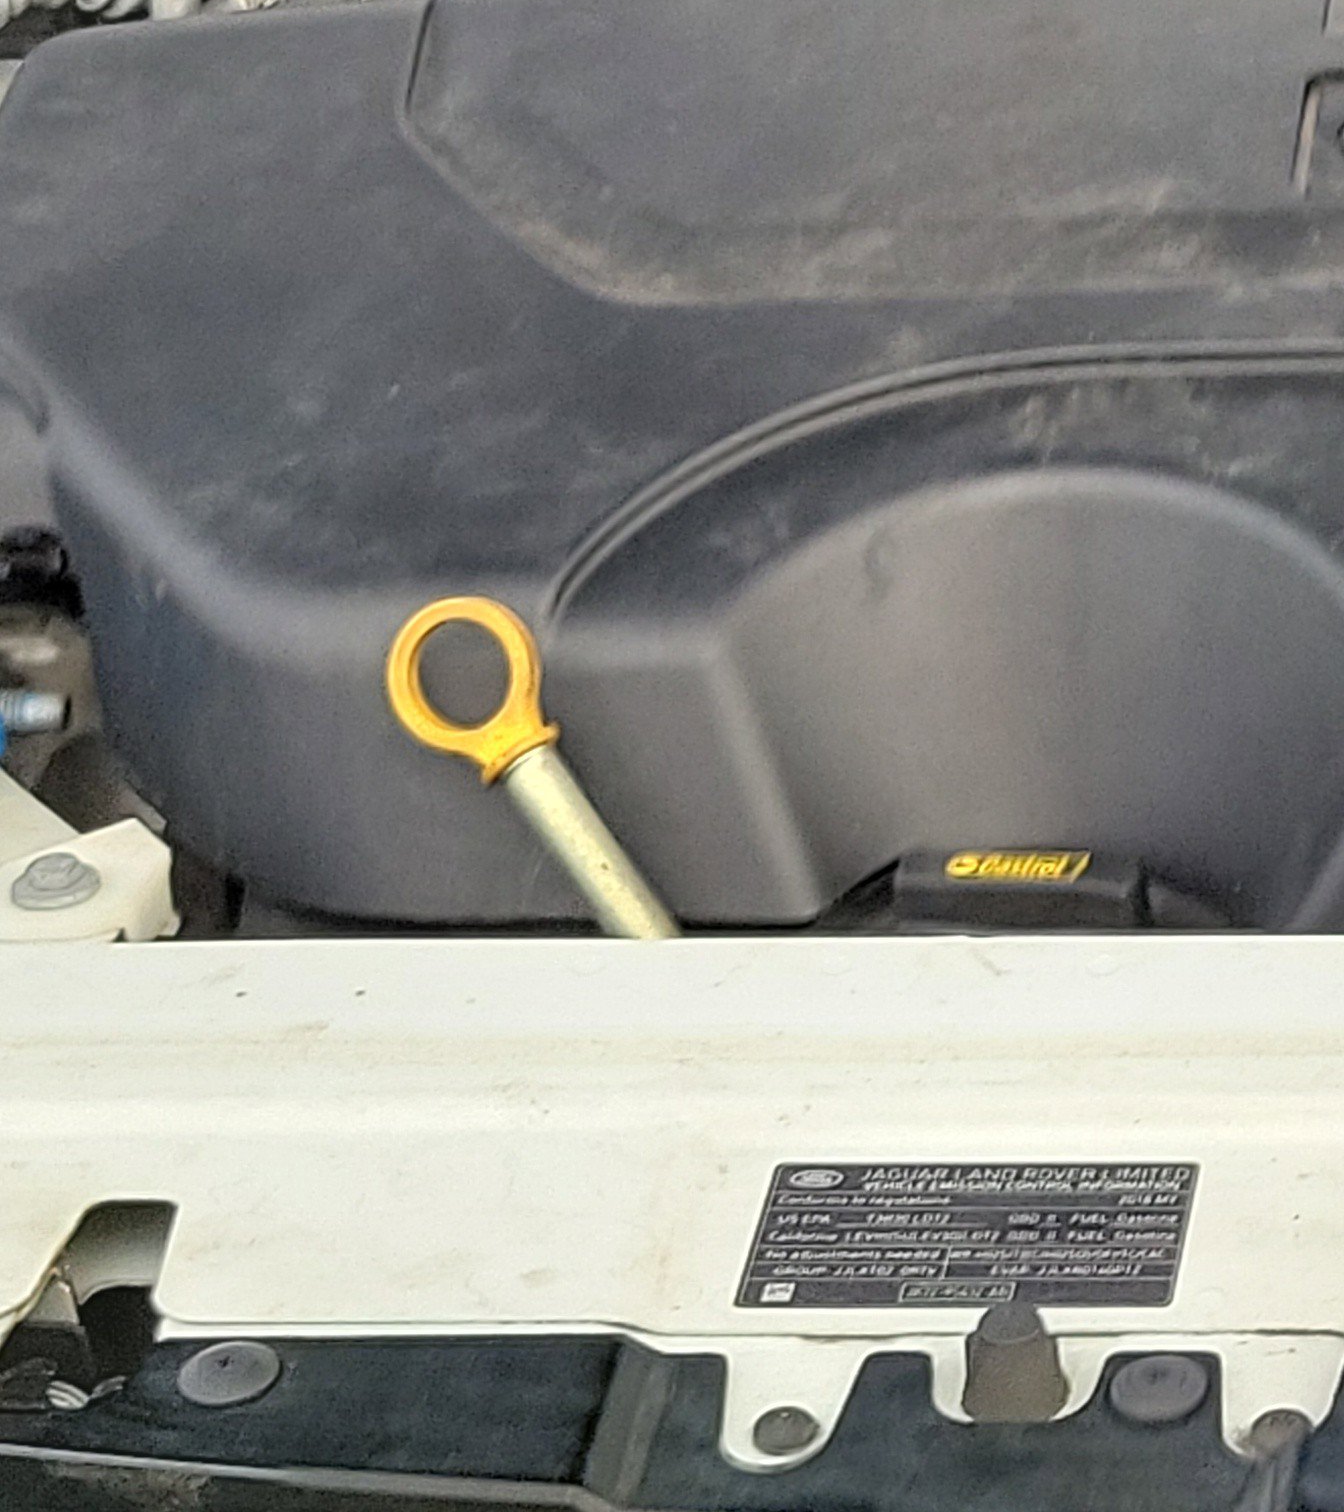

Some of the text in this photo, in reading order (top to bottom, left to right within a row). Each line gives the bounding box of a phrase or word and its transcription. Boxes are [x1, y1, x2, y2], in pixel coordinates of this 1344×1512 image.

[978, 852, 1070, 876] Castrol
[860, 1167, 950, 1182] JAGUAR
[953, 1167, 1018, 1180] LAND
[1022, 1167, 1097, 1180] ROVER
[1101, 1166, 1191, 1180] LIMITED
